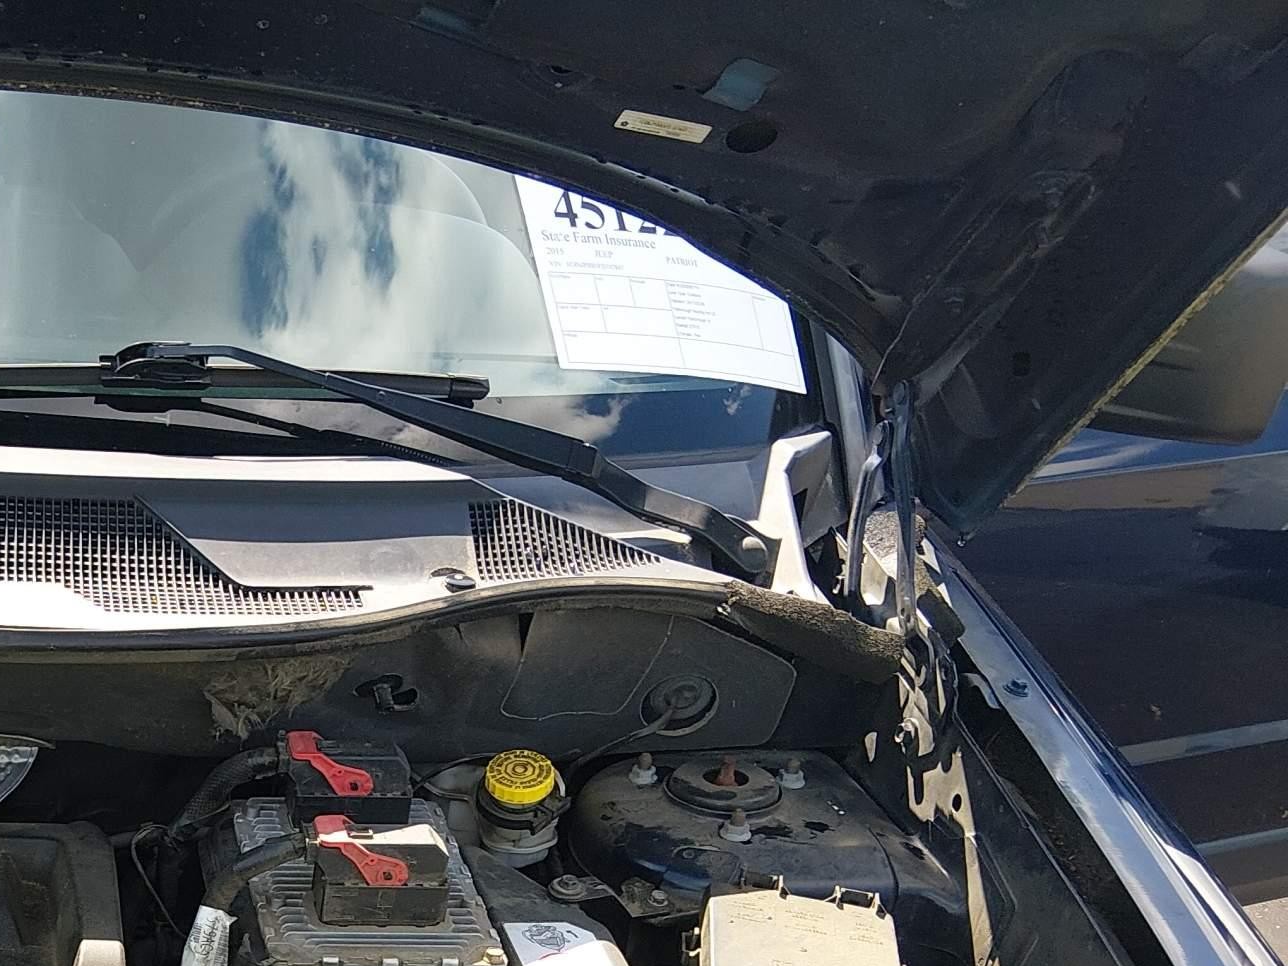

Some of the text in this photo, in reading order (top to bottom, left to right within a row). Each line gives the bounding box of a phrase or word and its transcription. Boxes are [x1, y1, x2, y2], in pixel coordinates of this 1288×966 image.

[541, 229, 657, 249] State Farm Insurance
[665, 256, 698, 267] PATRIOT
